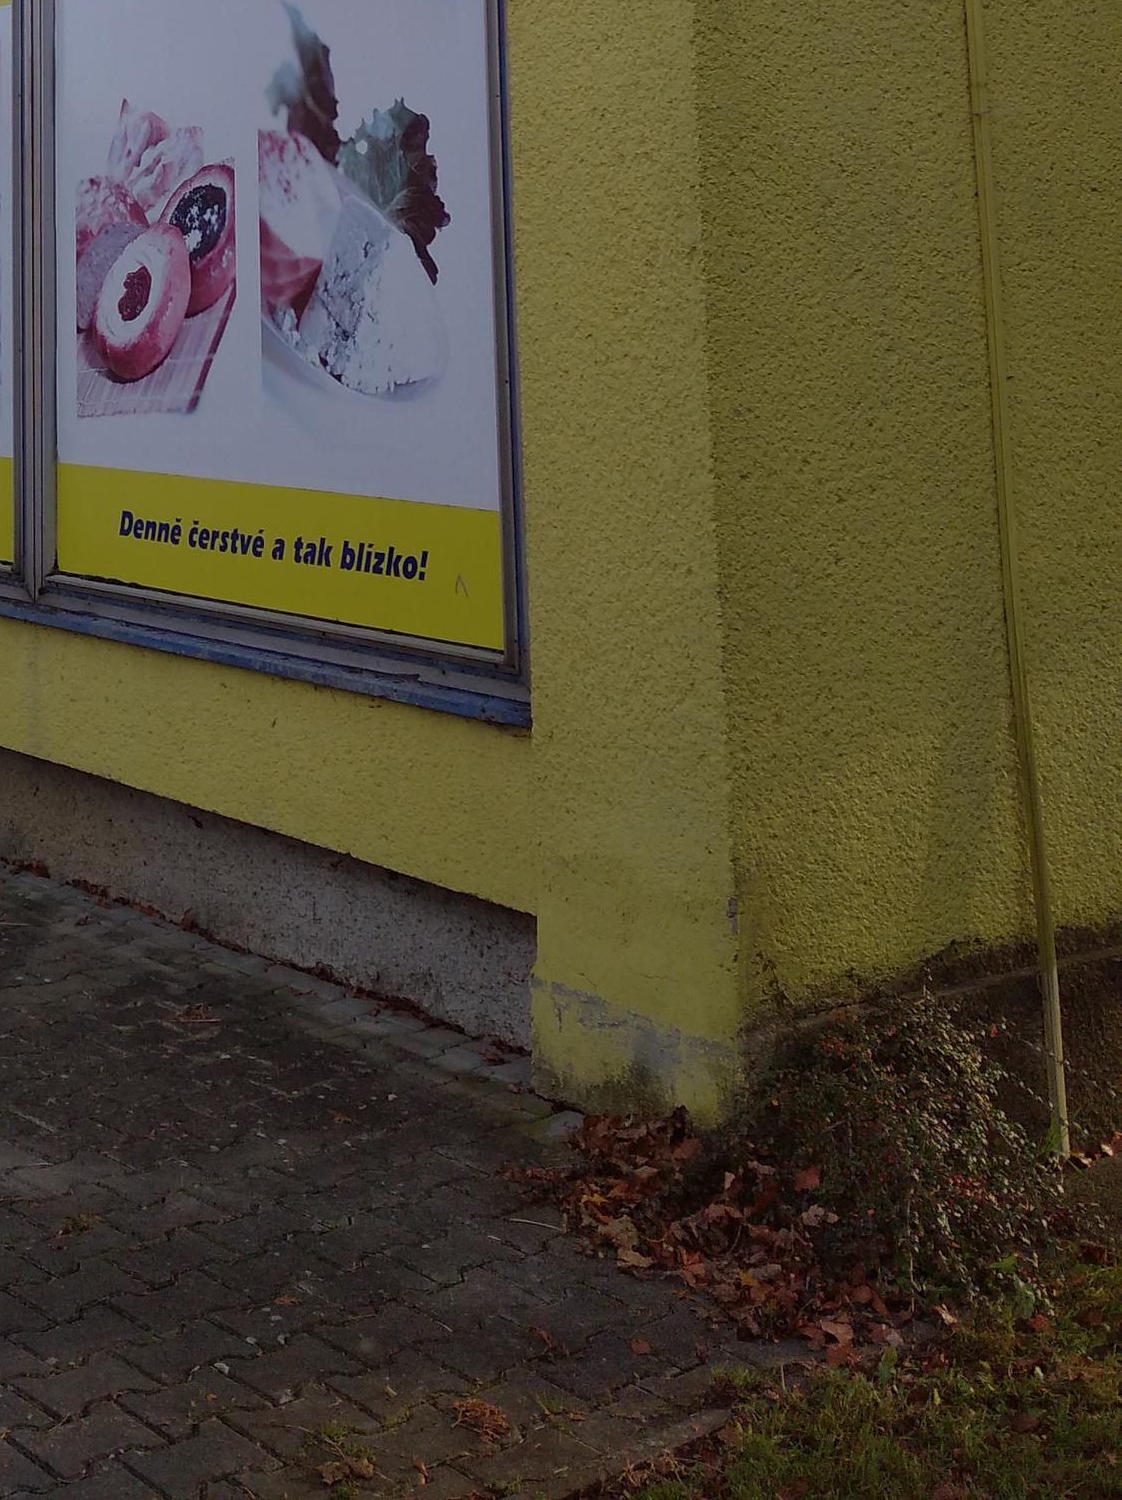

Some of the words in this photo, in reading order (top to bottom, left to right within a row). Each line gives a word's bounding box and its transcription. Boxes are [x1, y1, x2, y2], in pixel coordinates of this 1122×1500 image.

[119, 510, 182, 546] Denně
[188, 520, 265, 558] čerstvé
[271, 537, 285, 561] a
[293, 535, 332, 568] tak
[340, 540, 429, 581] blízko!
